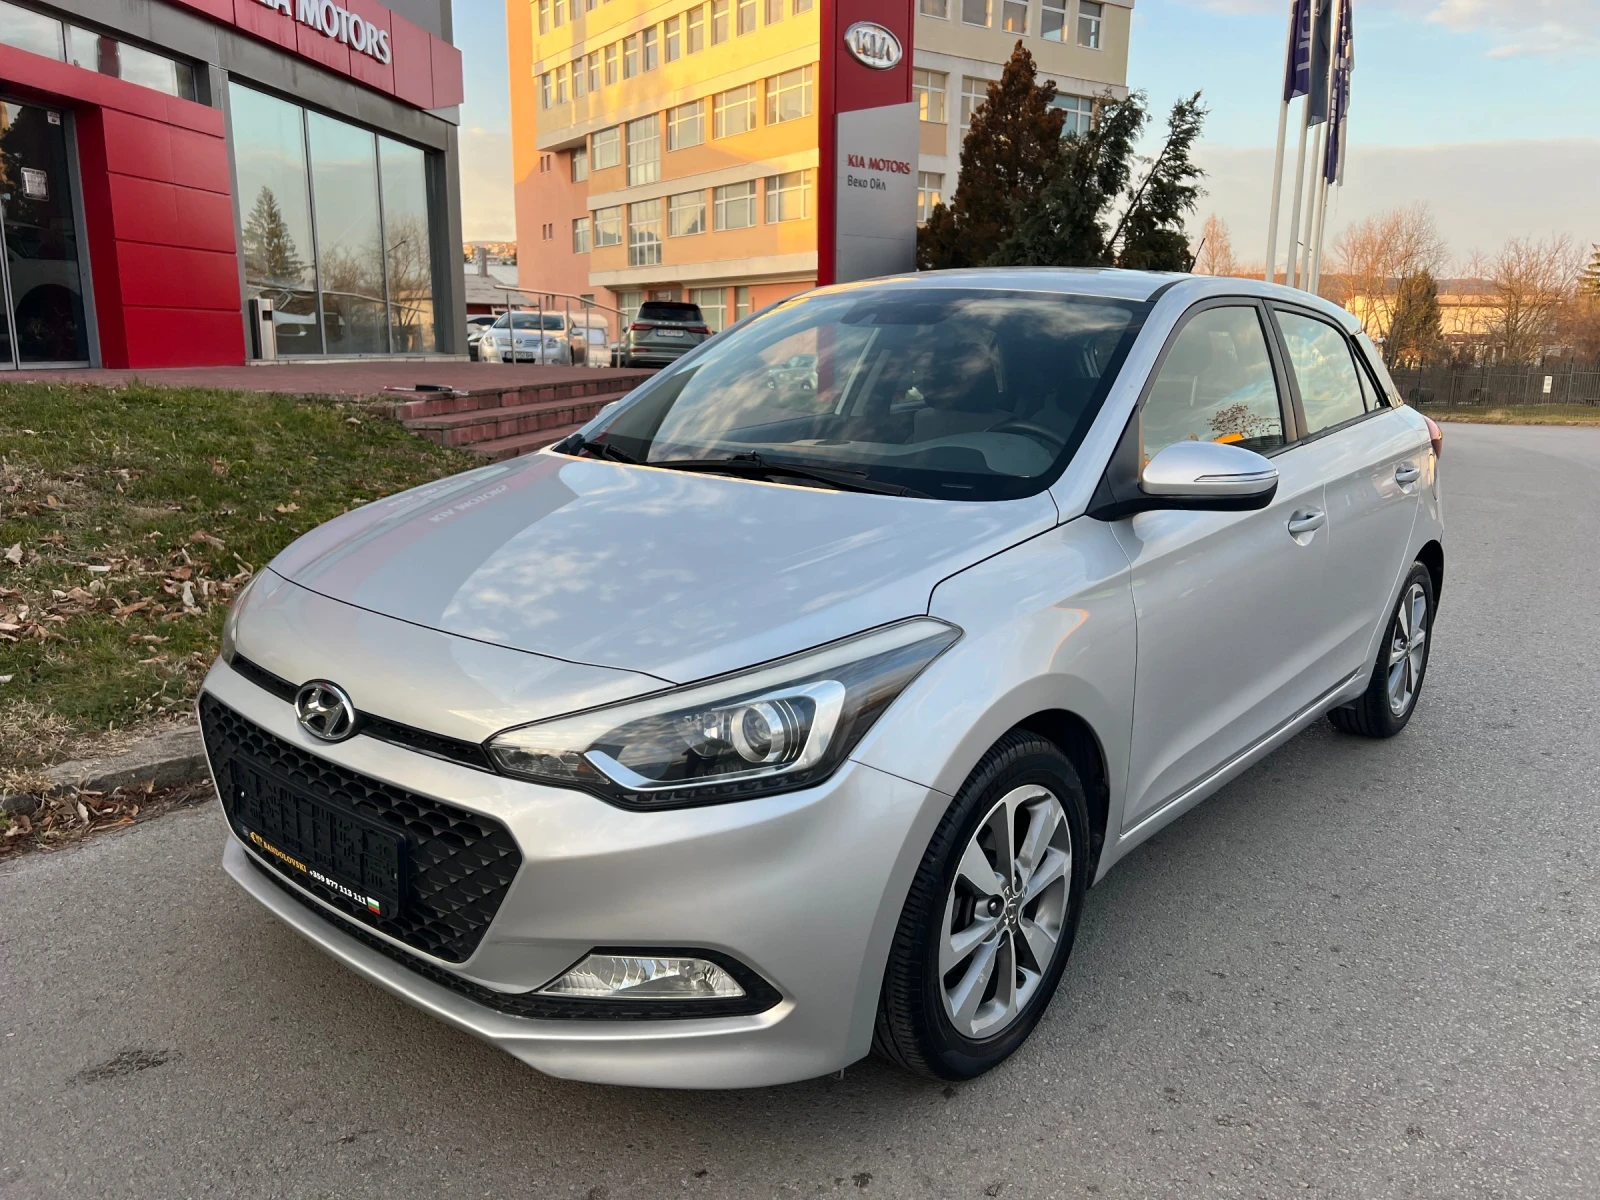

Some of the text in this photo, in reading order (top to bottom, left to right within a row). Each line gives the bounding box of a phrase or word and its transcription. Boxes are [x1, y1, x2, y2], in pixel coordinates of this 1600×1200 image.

[296, 0, 391, 64] MOTORS
[855, 29, 893, 62] KIA
[847, 153, 911, 175] KIA MOTORS
[847, 174, 887, 191] Веко Ойл
[309, 870, 326, 883] +359
[325, 877, 338, 889] 877
[352, 892, 367, 905] 111
